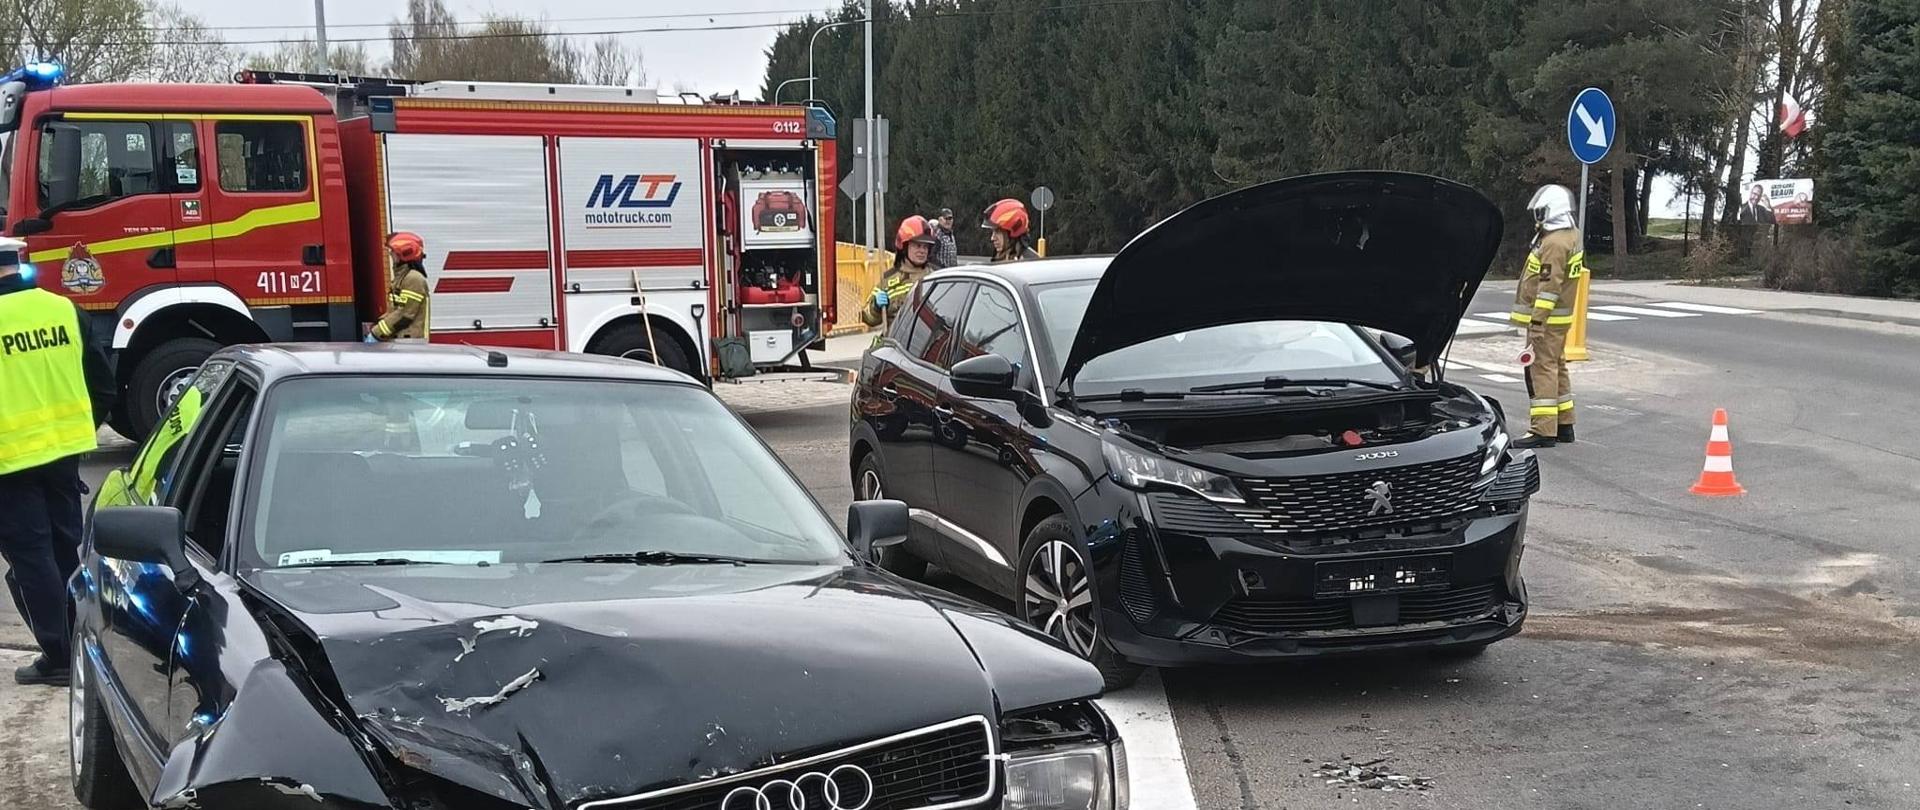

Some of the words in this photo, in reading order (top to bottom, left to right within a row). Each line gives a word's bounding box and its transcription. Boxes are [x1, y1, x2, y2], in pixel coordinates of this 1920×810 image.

[783, 121, 800, 134] 112
[584, 211, 672, 224] mototruck.com
[256, 271, 287, 294] 411
[300, 270, 321, 293] 21
[1, 324, 71, 355] POLICJA
[1355, 450, 1399, 461] 3008
